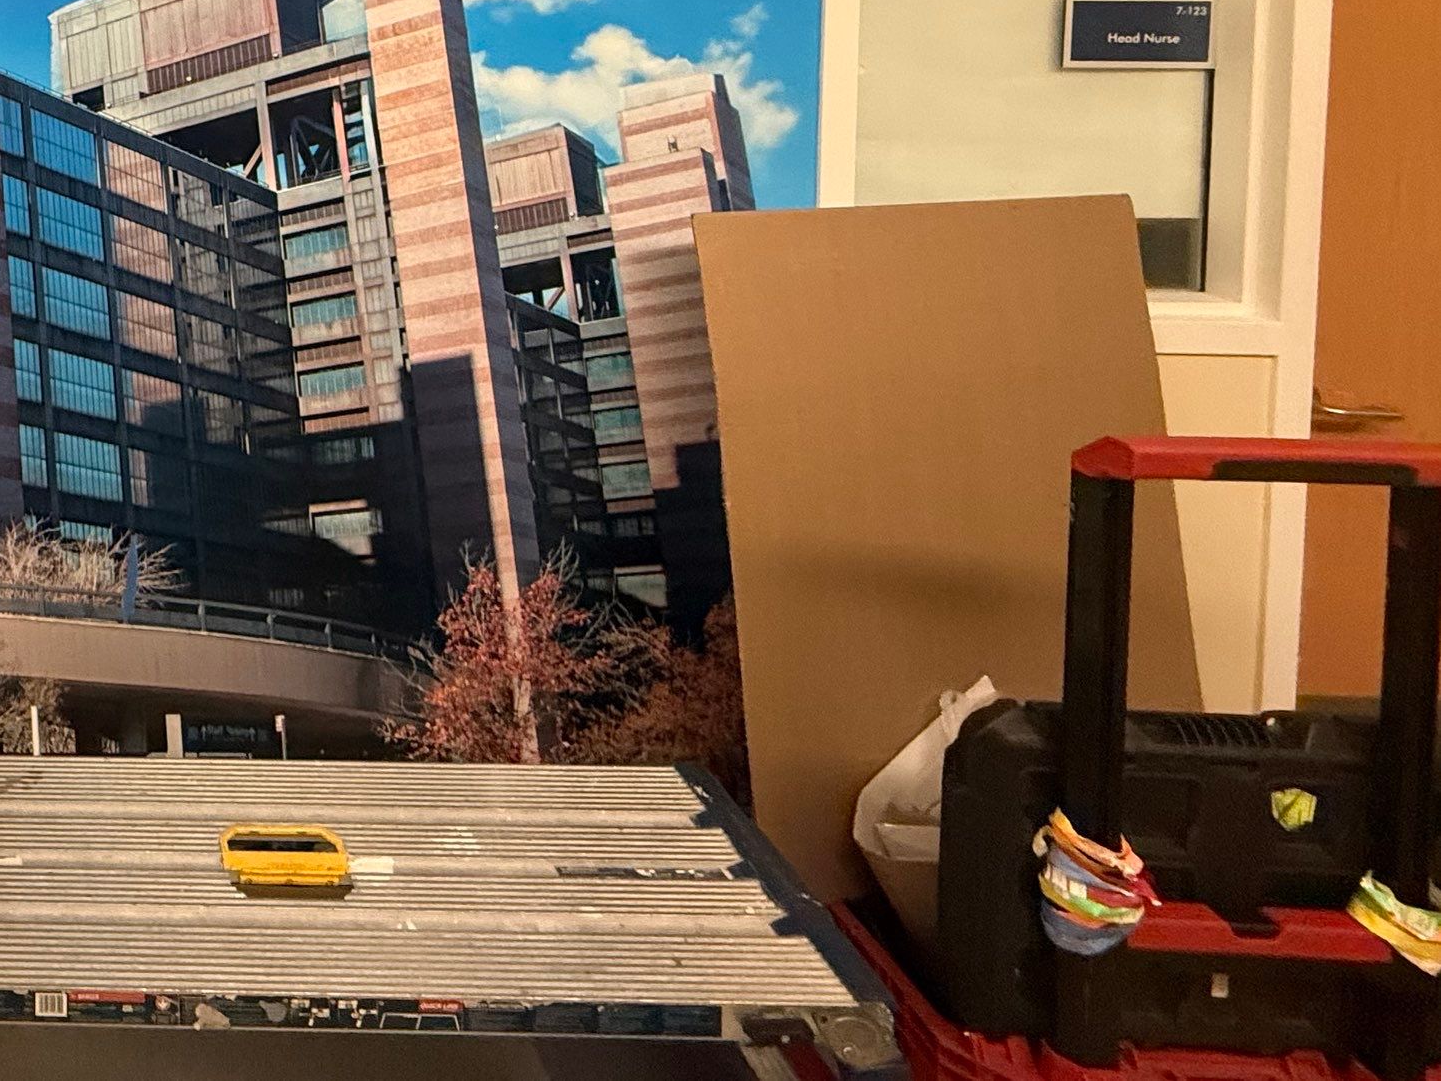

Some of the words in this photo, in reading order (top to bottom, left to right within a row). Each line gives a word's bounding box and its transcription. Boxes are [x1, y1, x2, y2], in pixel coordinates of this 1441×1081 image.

[1176, 6, 1207, 16] 7-123
[1107, 32, 1140, 44] Head
[1144, 33, 1180, 44] Nurse
